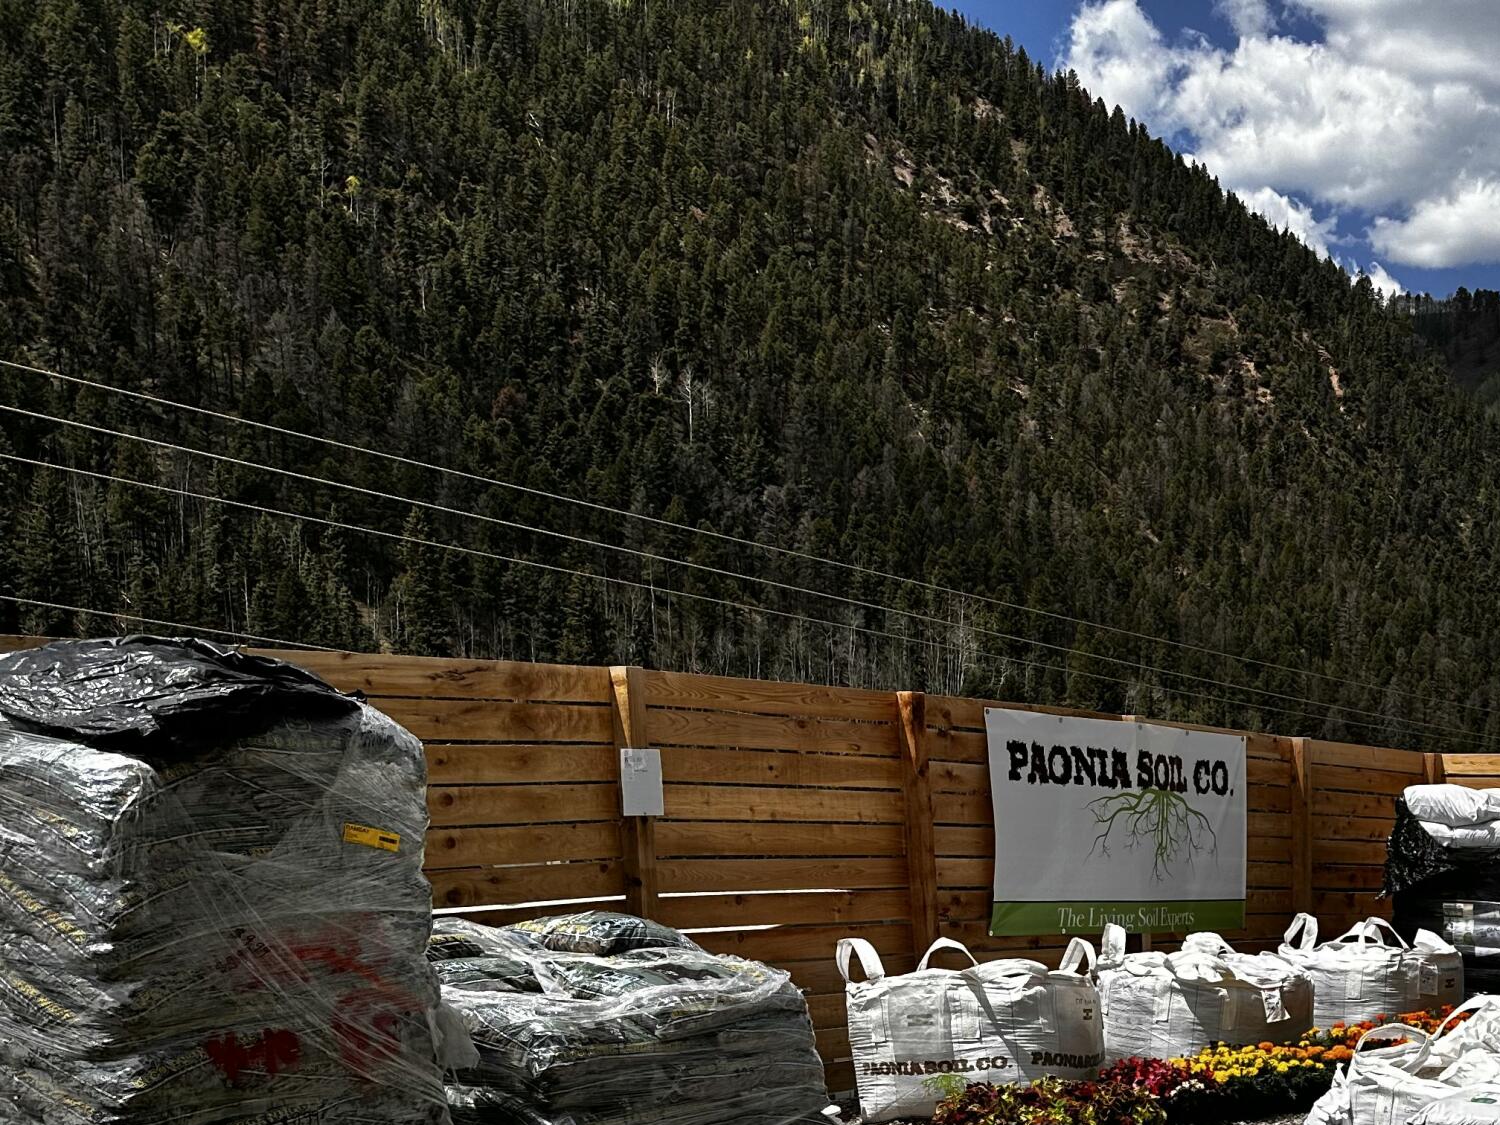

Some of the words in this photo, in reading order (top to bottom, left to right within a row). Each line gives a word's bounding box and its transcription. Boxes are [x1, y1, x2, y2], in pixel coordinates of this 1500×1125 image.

[1006, 740, 1132, 789] PAONIA
[1136, 749, 1187, 793] SOIL
[1193, 759, 1234, 796] CO.
[1058, 907, 1085, 927] The
[1088, 907, 1135, 934] Living
[1137, 906, 1159, 927] Soil
[1160, 906, 1195, 931] Experts
